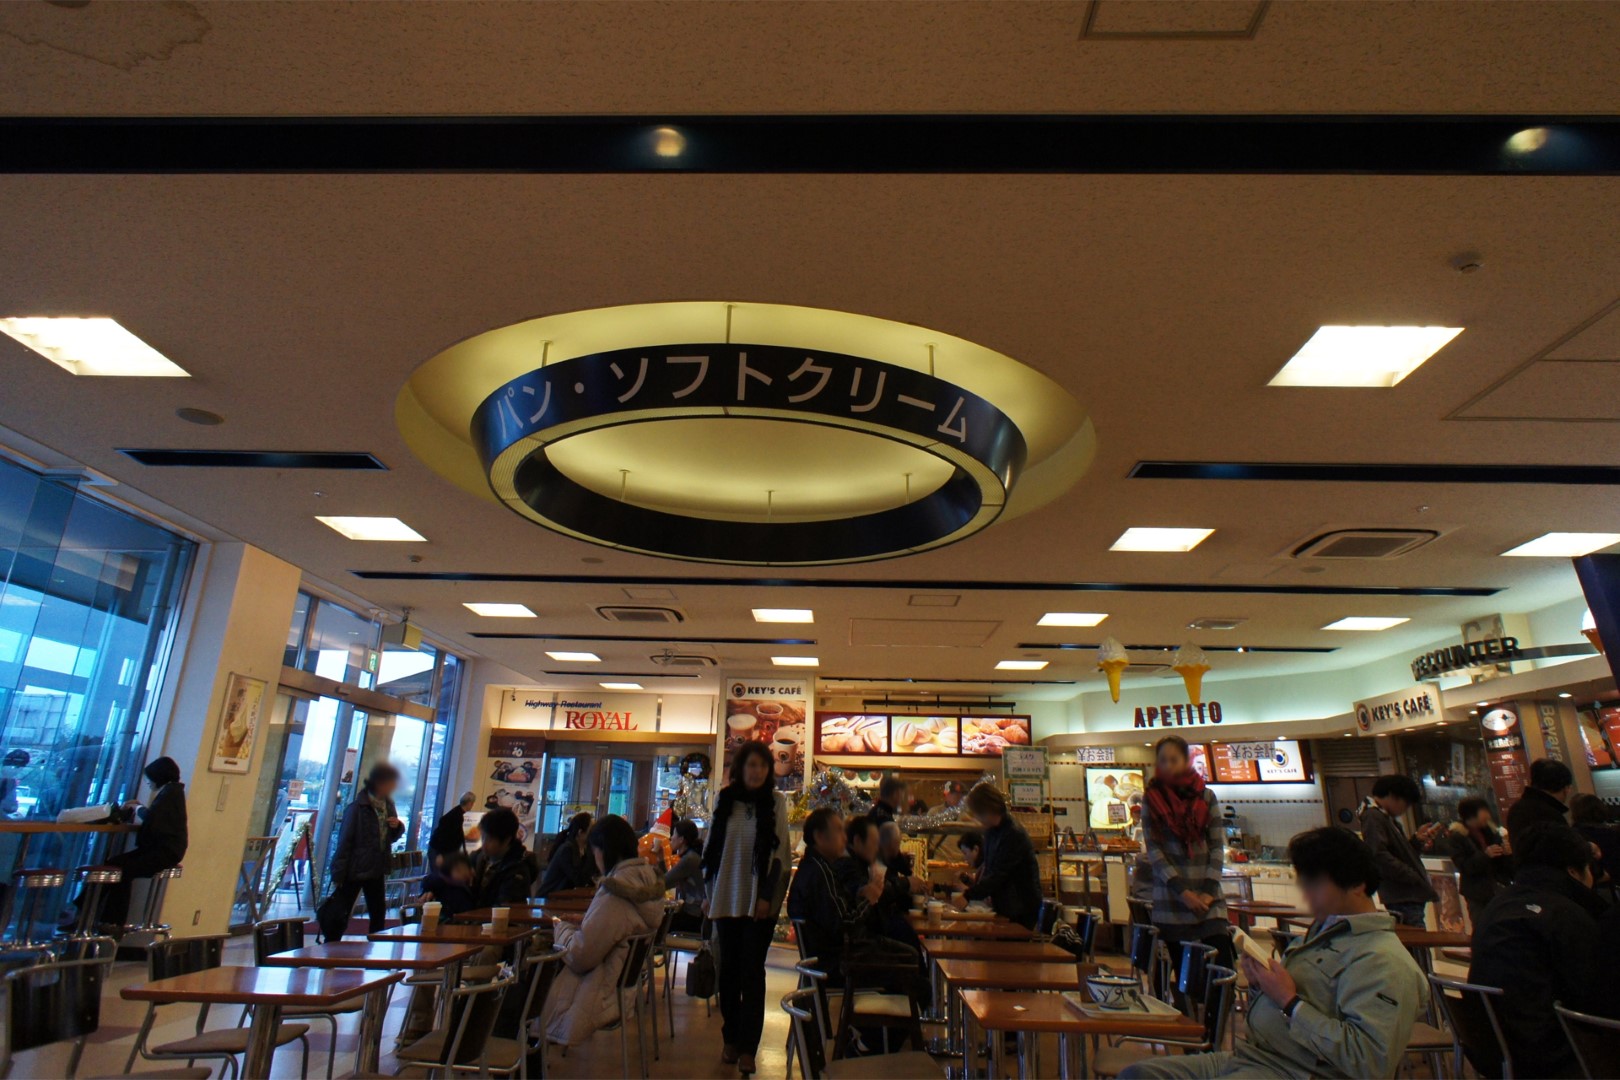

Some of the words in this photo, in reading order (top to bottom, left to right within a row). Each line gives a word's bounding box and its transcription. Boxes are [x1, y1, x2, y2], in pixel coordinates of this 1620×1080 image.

[497, 350, 969, 443] パン・ソフトクリーム
[748, 686, 776, 695] KEY'S
[778, 684, 802, 695] CAFÉ
[525, 699, 558, 709] Highway
[560, 700, 603, 709] Restaurant
[1134, 701, 1223, 728] APETITO
[1371, 702, 1401, 722] KEY'S
[1402, 692, 1431, 715] CAFÉ
[565, 710, 638, 731] ROYAL
